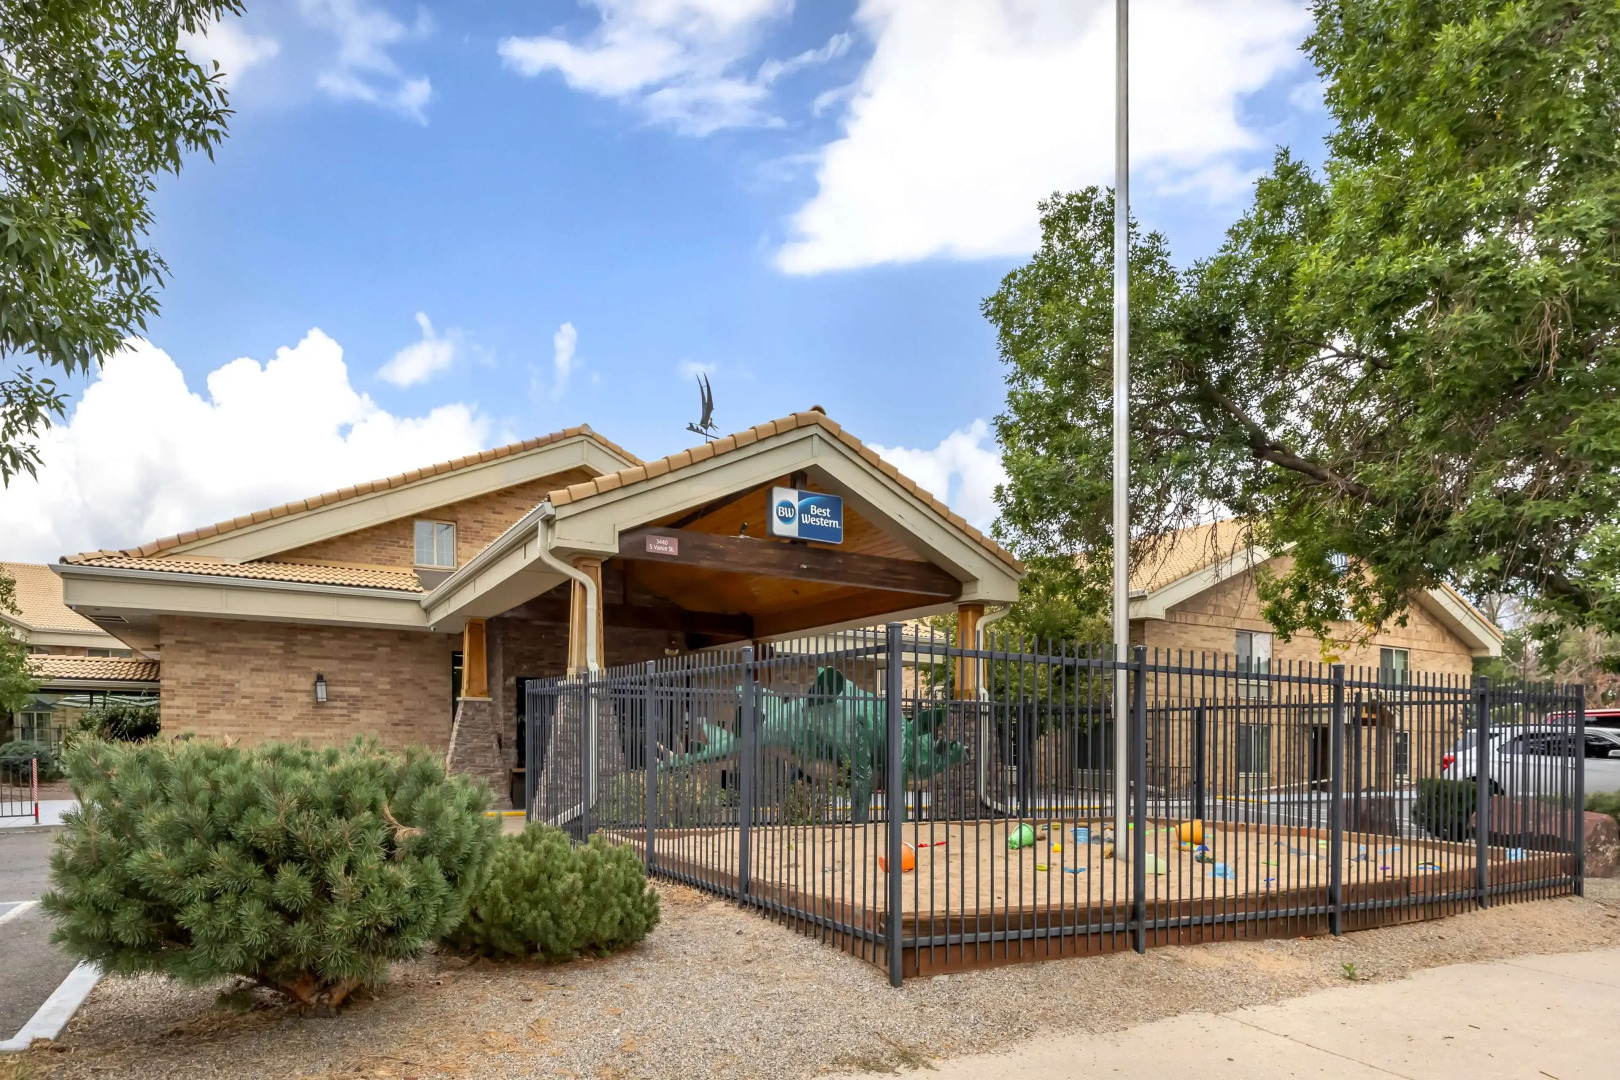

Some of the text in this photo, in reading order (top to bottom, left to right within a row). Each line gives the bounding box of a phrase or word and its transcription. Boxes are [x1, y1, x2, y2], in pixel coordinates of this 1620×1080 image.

[778, 506, 794, 518] BW
[810, 504, 831, 517] Best
[801, 513, 839, 528] Western
